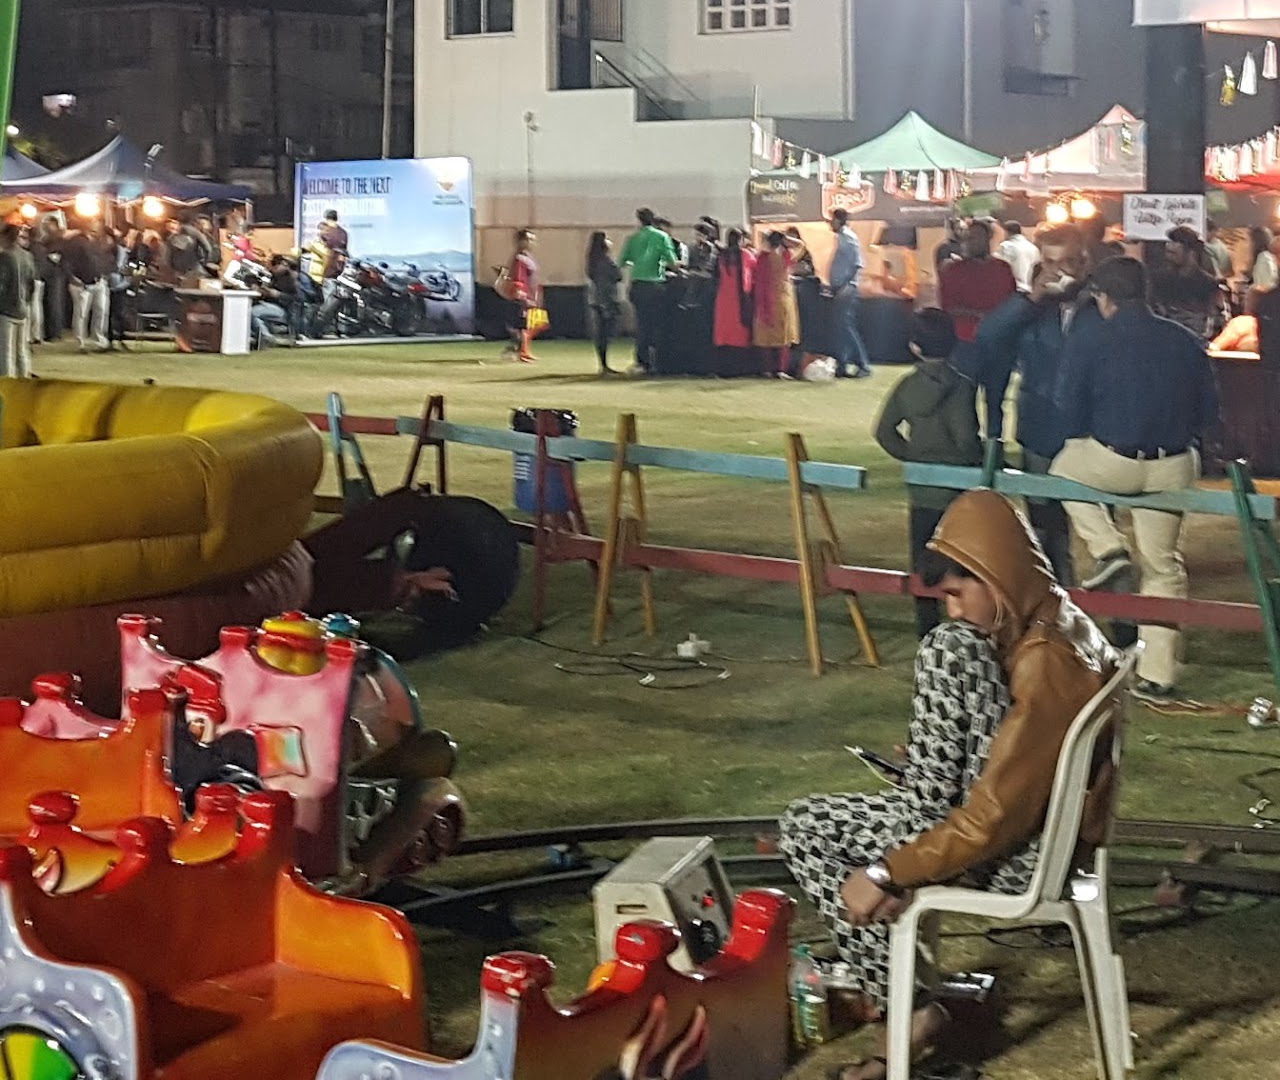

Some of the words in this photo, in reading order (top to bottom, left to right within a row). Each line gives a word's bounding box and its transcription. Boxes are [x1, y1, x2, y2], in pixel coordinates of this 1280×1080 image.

[303, 177, 339, 195] WELCOME
[341, 177, 351, 195] TO
[354, 176, 369, 195] THE
[370, 176, 392, 195] NEXT
